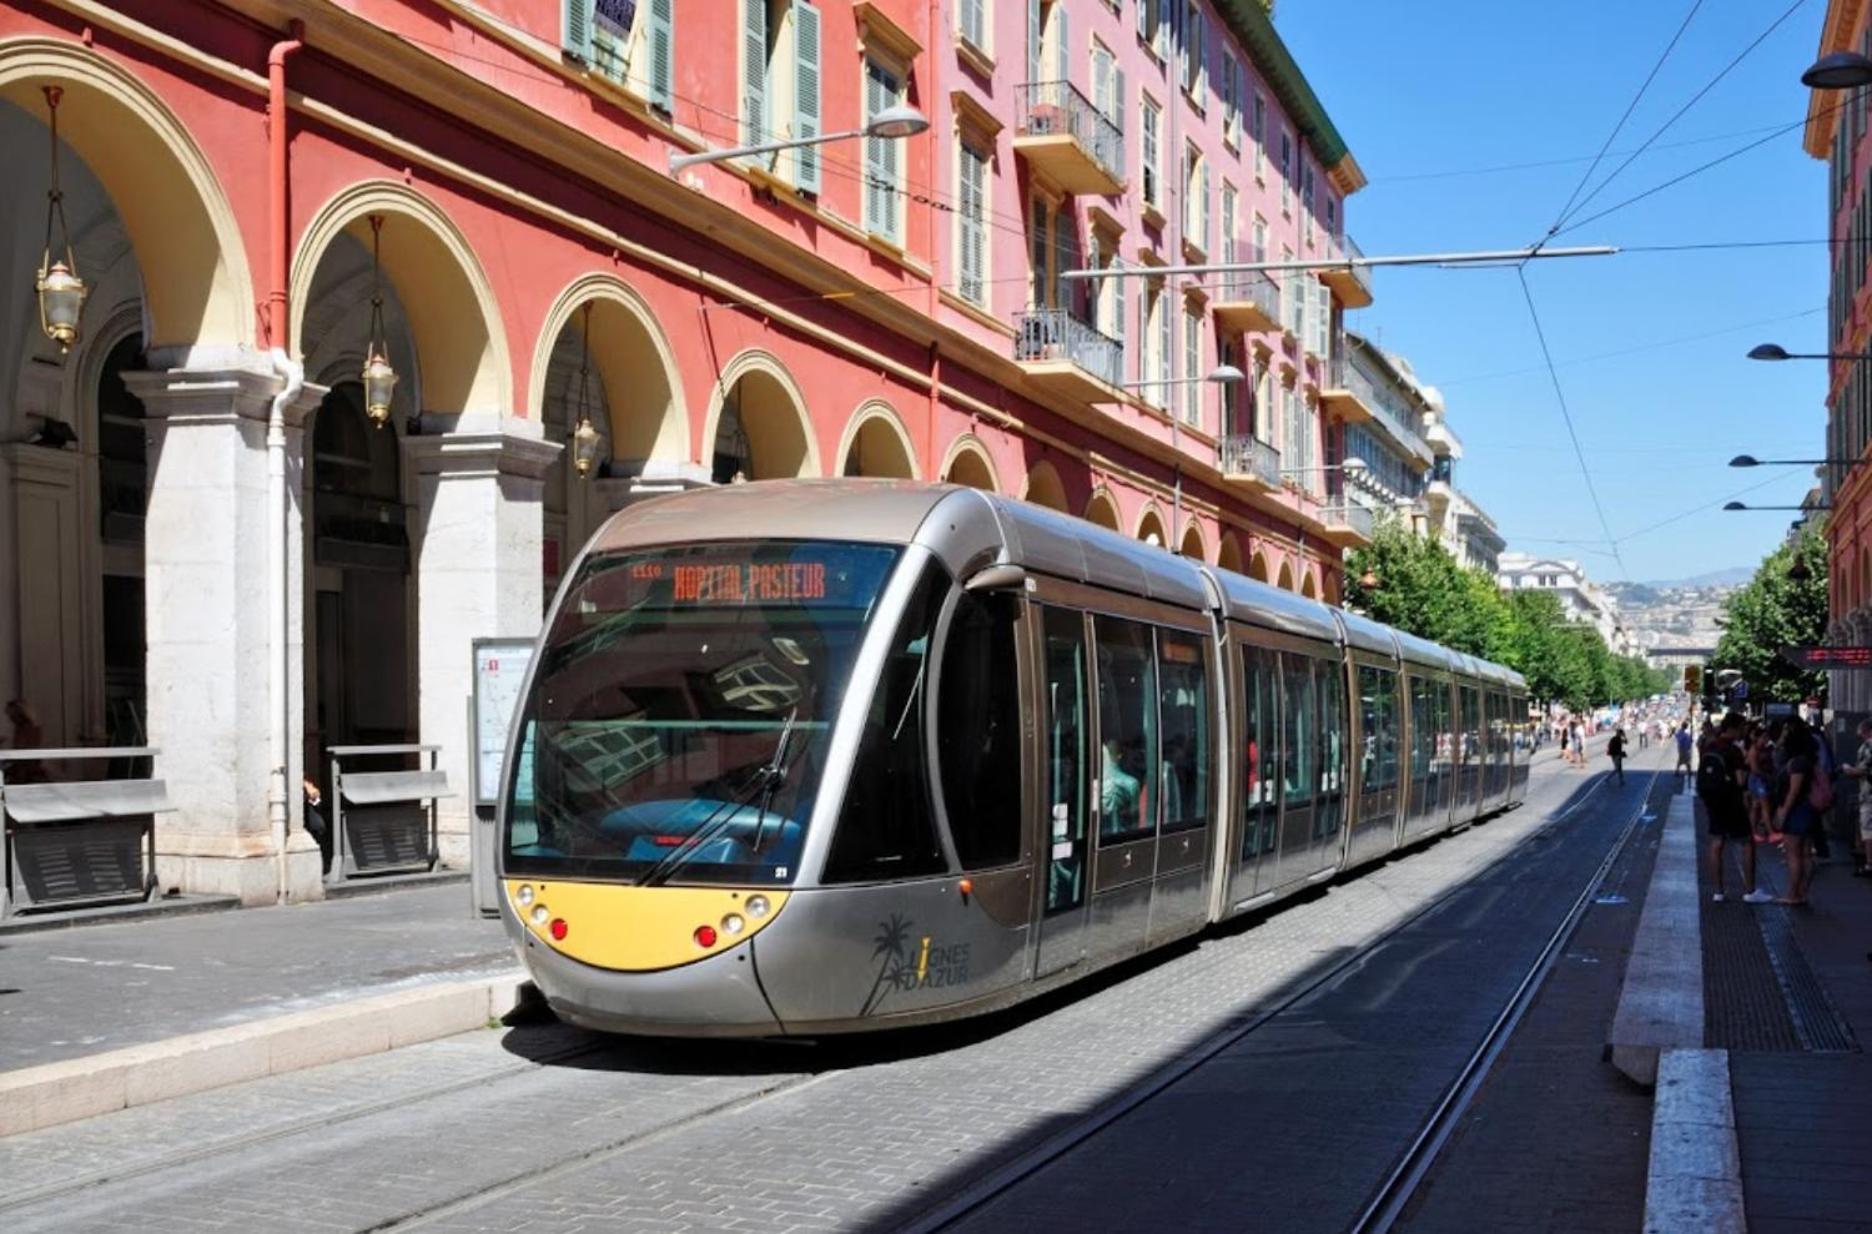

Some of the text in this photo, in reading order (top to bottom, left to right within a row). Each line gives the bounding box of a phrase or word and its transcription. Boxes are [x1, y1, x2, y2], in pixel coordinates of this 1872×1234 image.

[675, 565, 744, 599] HOPITAL
[749, 563, 825, 598] PASTEUR
[908, 936, 970, 970] LIGNES
